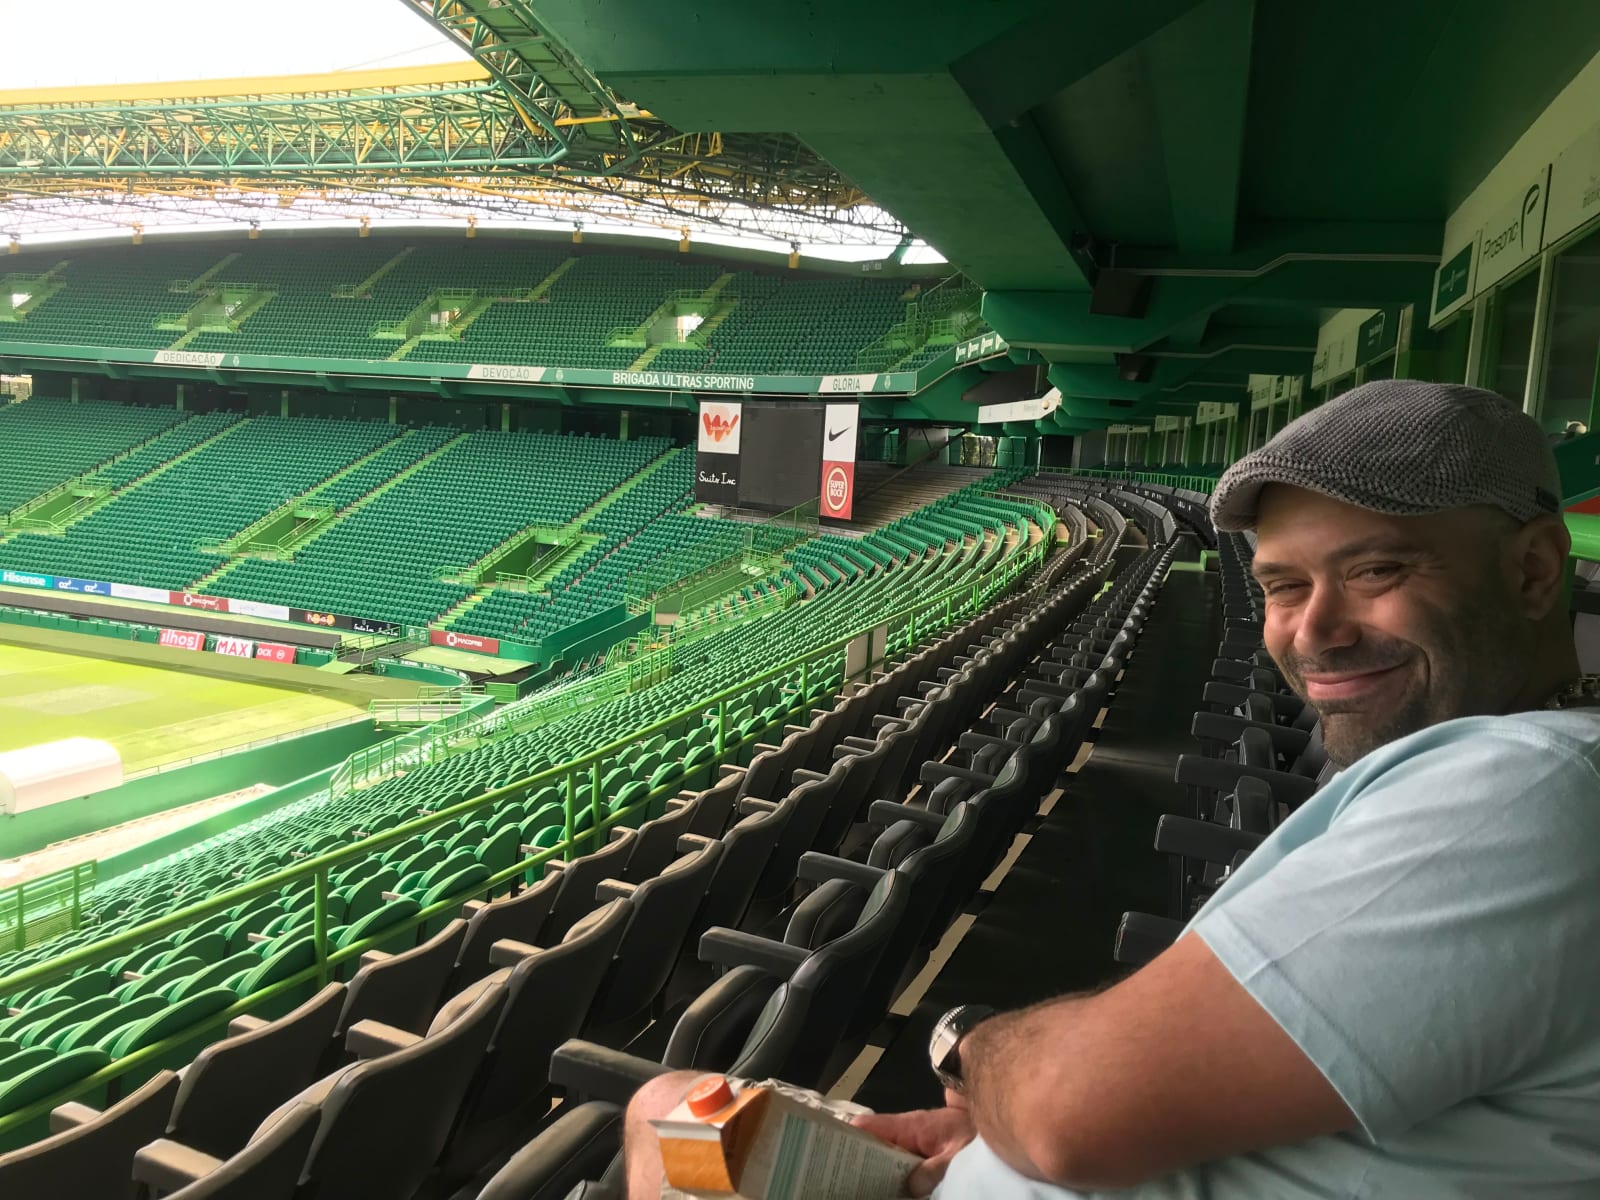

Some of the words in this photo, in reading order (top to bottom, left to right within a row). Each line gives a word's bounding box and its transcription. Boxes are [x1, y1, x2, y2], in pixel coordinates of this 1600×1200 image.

[612, 372, 660, 386] BRIGADA
[662, 374, 702, 388] ULTRAS
[703, 376, 754, 390] SPORTING
[830, 480, 844, 490] SUPER
[3, 571, 46, 586] Hisense
[217, 641, 249, 657] MAX
